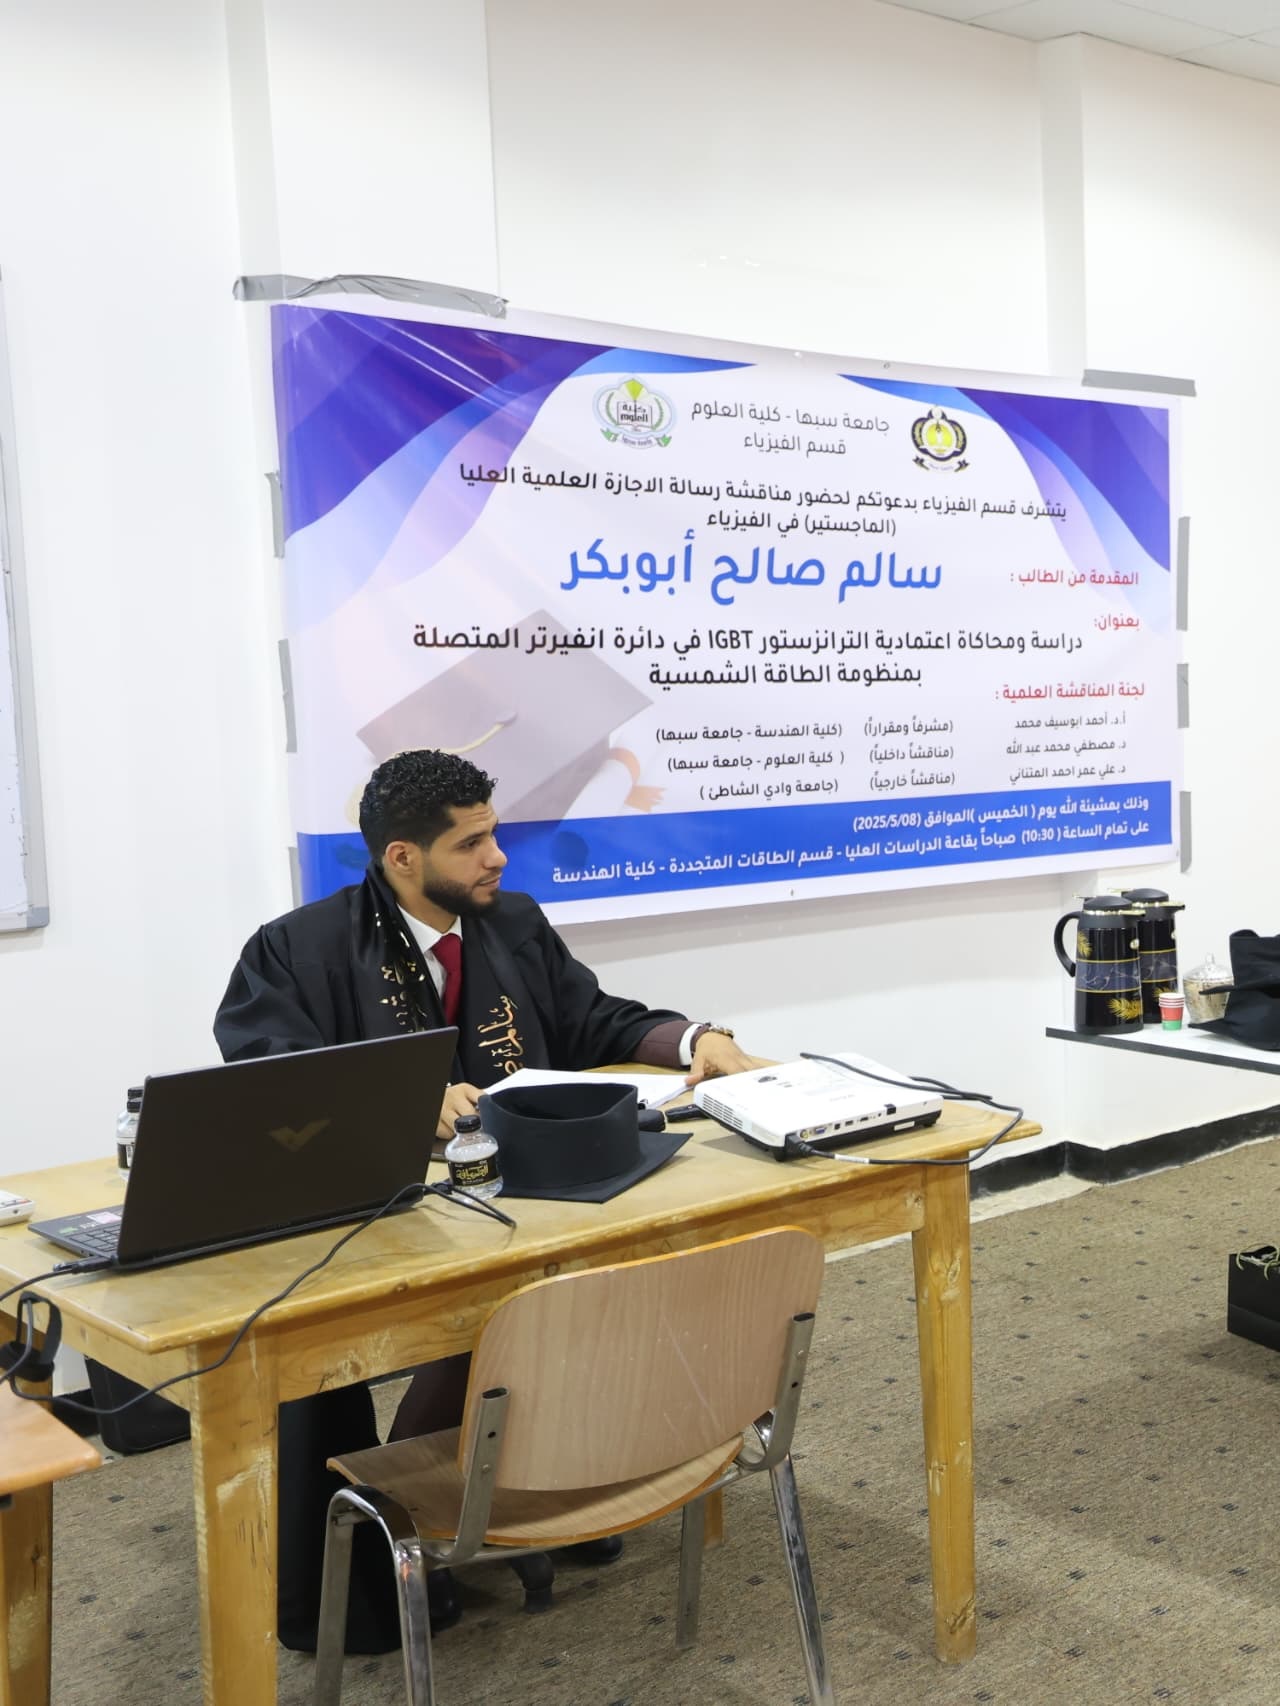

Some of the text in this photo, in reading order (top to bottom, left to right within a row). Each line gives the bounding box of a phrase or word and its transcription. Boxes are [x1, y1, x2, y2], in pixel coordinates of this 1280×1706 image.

[691, 400, 743, 420] العلوم
[749, 402, 781, 425] كلية
[796, 408, 838, 430] سبها
[843, 411, 889, 435] جامعة
[744, 432, 846, 458] قسم الفيزياء
[460, 463, 1067, 522] يتشرف قسم الفيزياء بدعوتكم لحضور مناقشة رسالة الاجازة العلمية العليا
[707, 510, 896, 538] (الماجستير) في الفيزياء
[560, 528, 941, 605] سالم صالح أبوبكر
[1018, 569, 1064, 587] الطالب
[1068, 573, 1086, 587] من
[1090, 569, 1138, 586] المقدمة
[1093, 613, 1140, 631] بعنوان:
[413, 624, 1082, 661] دراسة ومحاكاة اعتمادية الترانزستور IGBT في دائرة انفيرتر المتصلة
[649, 660, 921, 691] بمنظومة الطاقة الشمسية
[1003, 684, 1052, 703] العلمية
[1056, 681, 1114, 699] المناقشة
[1119, 681, 1144, 701] لجنة
[754, 724, 808, 738] الهندسة
[813, 723, 842, 739] (كلية
[1015, 718, 1042, 729] محمد
[1045, 715, 1082, 730] ابوسيف
[656, 728, 698, 744] سبها)
[702, 726, 743, 743] جامعة
[1006, 737, 1022, 754] الله
[1025, 744, 1041, 757] عبد
[1043, 742, 1070, 753] محمد
[667, 757, 709, 773] سبها)
[713, 755, 753, 771] جامعة
[764, 753, 805, 771] العلوم
[809, 751, 833, 767] كلية
[1077, 766, 1096, 778] عمر
[1098, 763, 1115, 781] علي
[763, 782, 792, 801] وادي
[795, 778, 839, 795] (جامعة
[1038, 804, 1057, 820] يوم
[1060, 795, 1077, 814] الله
[1079, 797, 1120, 815] بمشيئة
[1123, 796, 1149, 811] وذلك
[853, 812, 921, 833] (2025/5/08)
[978, 805, 1028, 823] الخميس
[1063, 824, 1101, 839] الساعة
[1104, 821, 1127, 840] تمام
[1130, 820, 1149, 836] على
[845, 842, 880, 861] العليا
[884, 838, 941, 855] الدراسات
[945, 834, 977, 851] بقاعة
[670, 855, 733, 876] المتجددة
[737, 849, 795, 867] الطاقات
[798, 845, 833, 868] قسم
[553, 864, 620, 884] الهندسة
[625, 860, 655, 881] كلية
